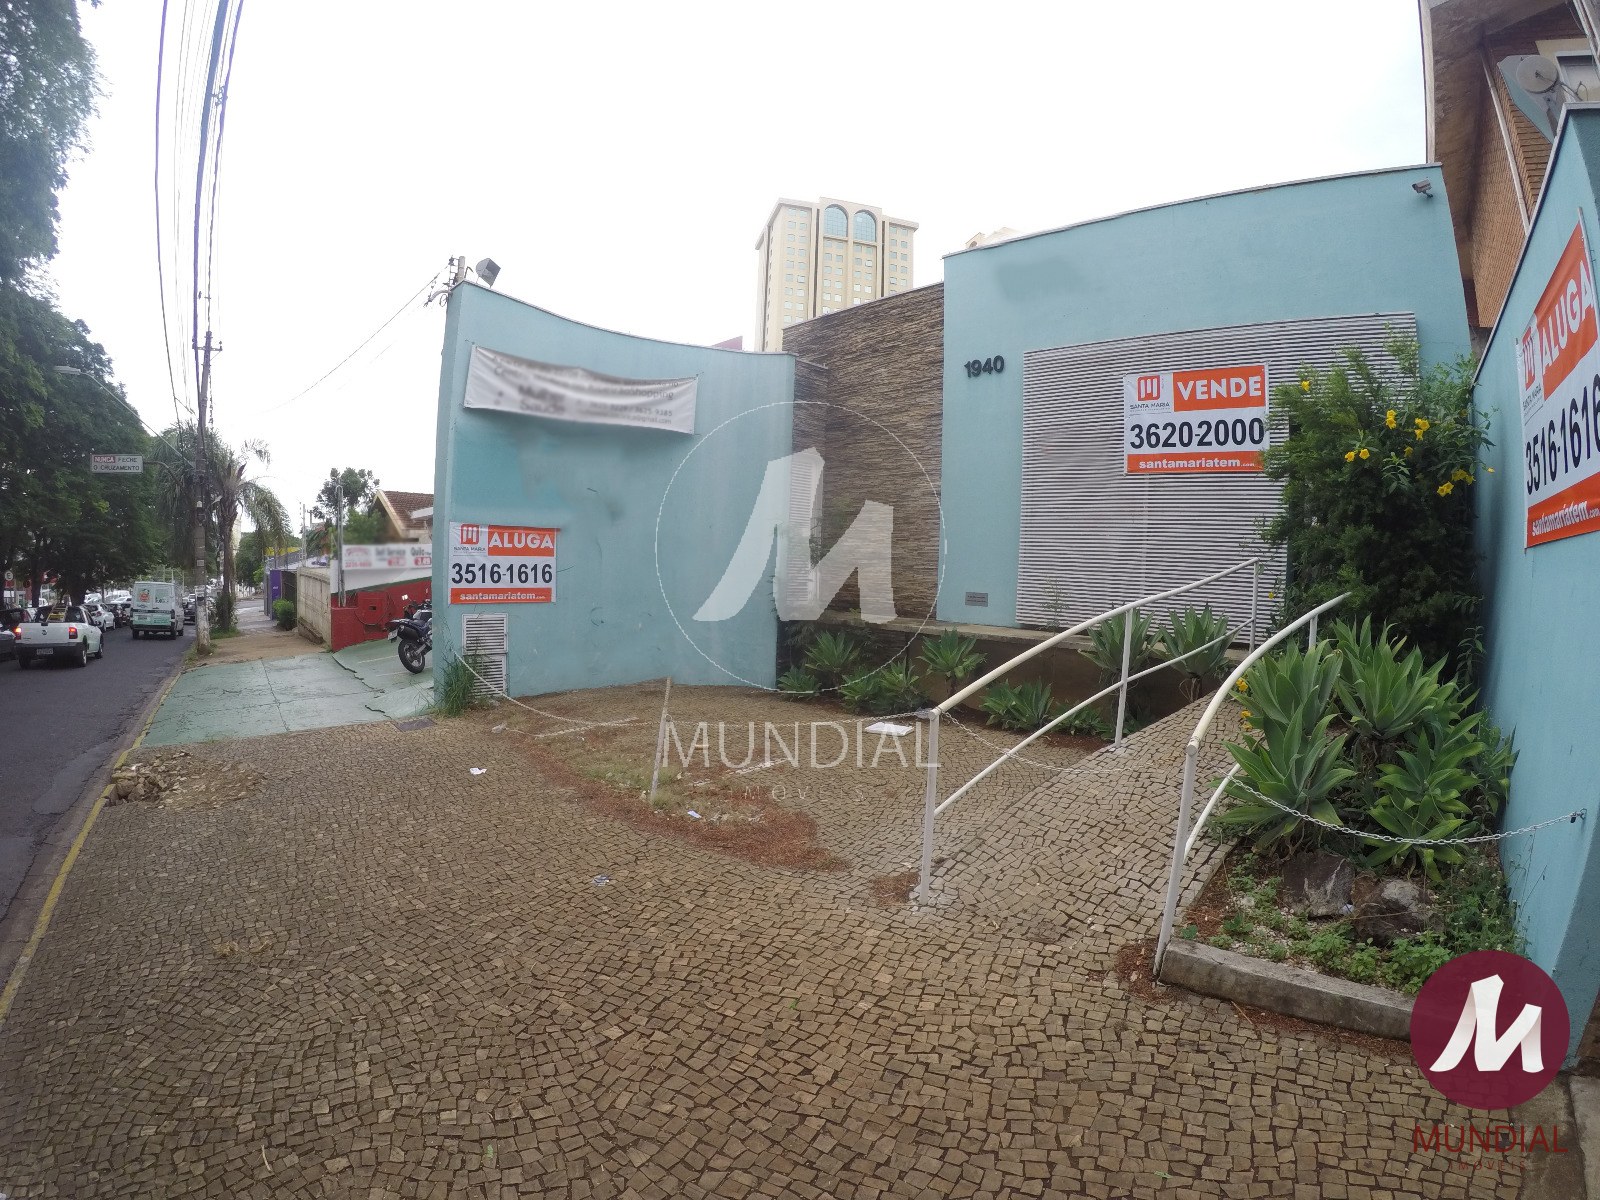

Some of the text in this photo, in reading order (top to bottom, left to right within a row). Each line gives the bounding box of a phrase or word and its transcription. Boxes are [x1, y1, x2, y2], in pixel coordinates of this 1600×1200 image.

[1542, 259, 1594, 376] ALUGA
[964, 354, 1005, 378] 1940
[1177, 375, 1262, 400] VENDE
[1130, 417, 1265, 449] 3620-2000
[1139, 457, 1255, 469] santamariatem.com
[488, 531, 554, 549] ALUGA
[451, 562, 553, 584] 3516-1616
